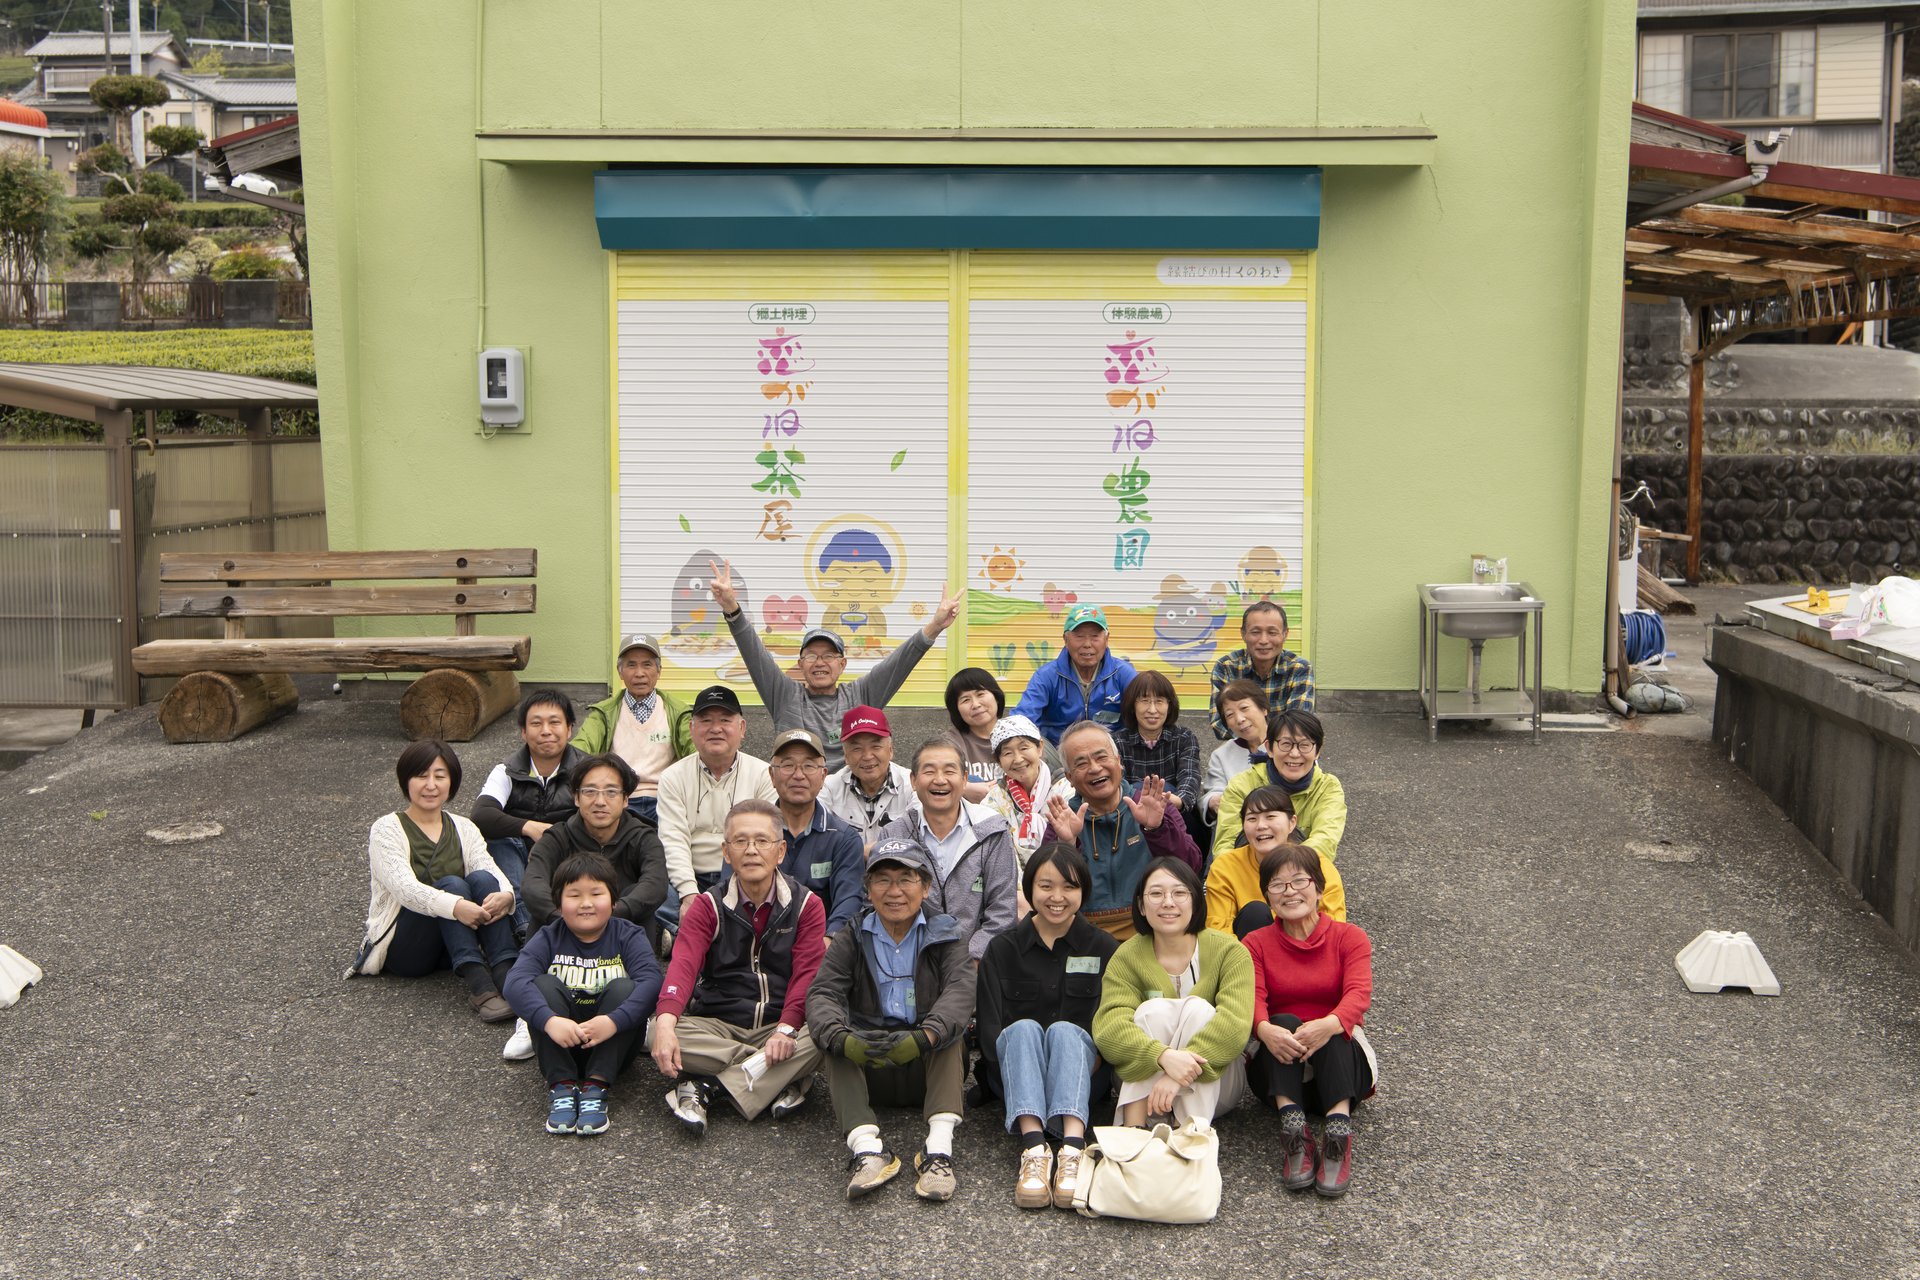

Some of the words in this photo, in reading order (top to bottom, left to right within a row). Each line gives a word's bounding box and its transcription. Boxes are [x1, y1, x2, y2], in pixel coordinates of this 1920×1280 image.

[756, 307, 808, 321] 郷土料理
[1111, 306, 1163, 320] 体験農場
[878, 841, 908, 853] KSAS
[575, 956, 599, 968] GLORY
